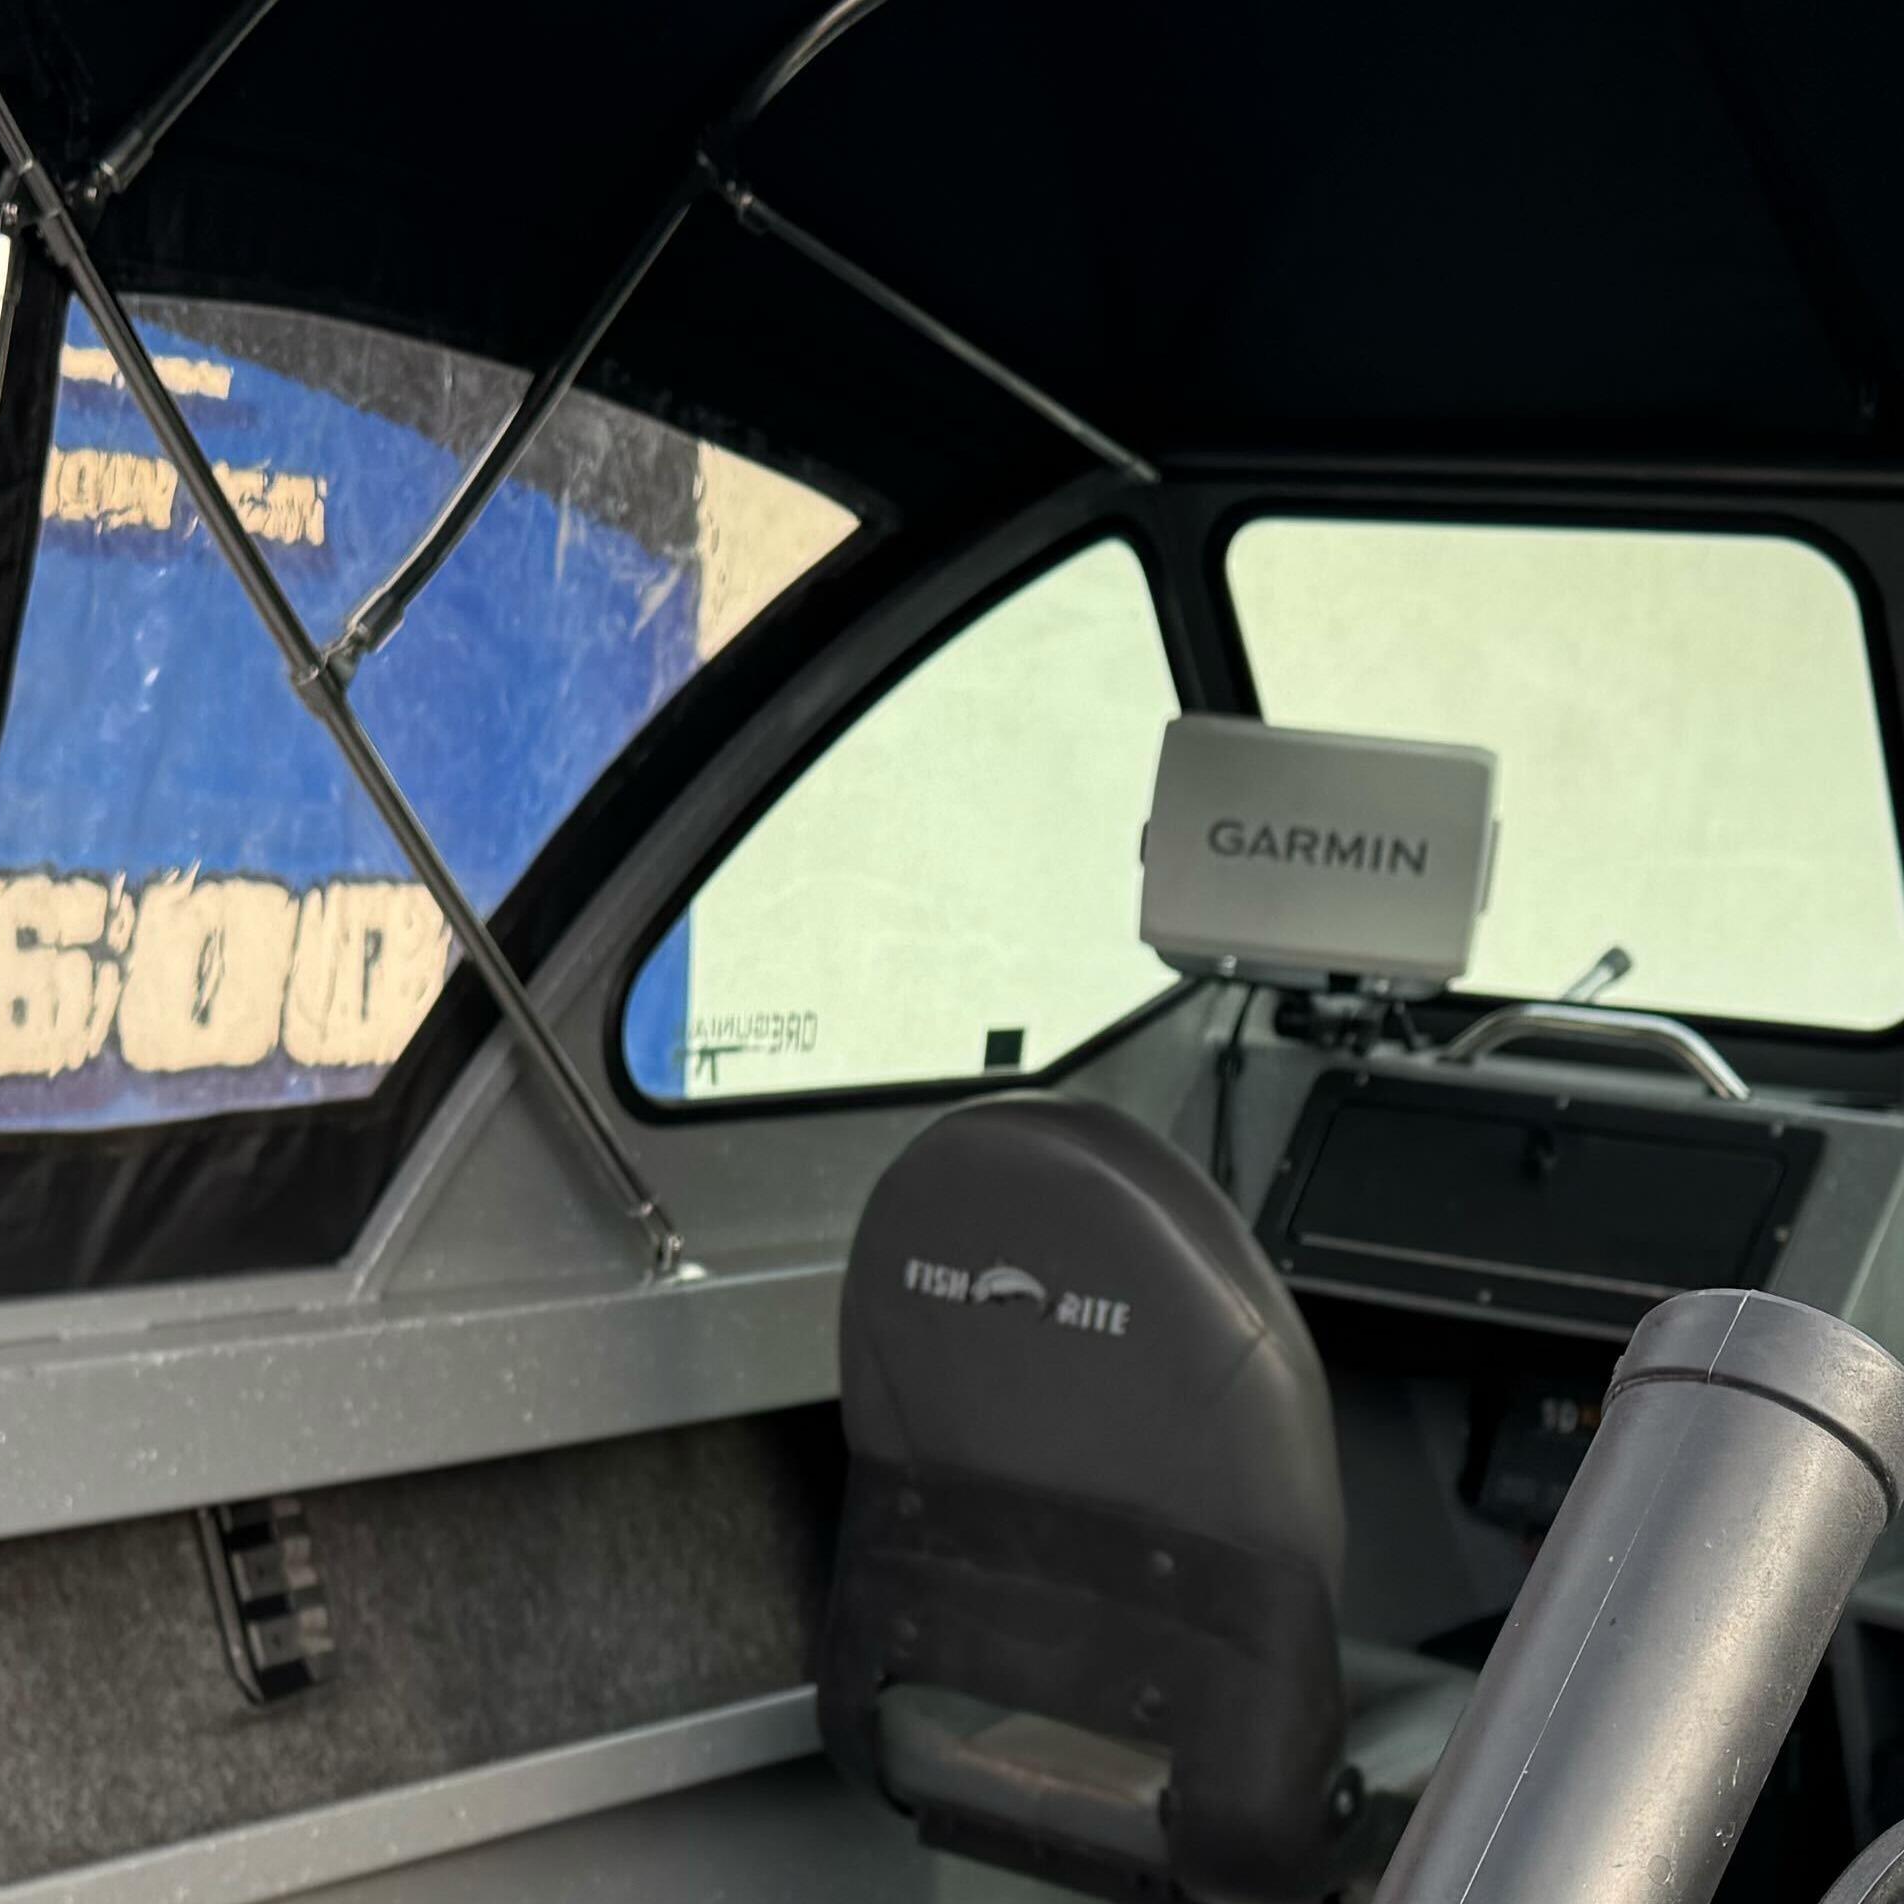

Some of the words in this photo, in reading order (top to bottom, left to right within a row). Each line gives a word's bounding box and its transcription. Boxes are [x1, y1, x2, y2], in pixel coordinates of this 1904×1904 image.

[1207, 818, 1429, 876] GARMIN
[905, 1258, 970, 1301] FISH
[1057, 1291, 1131, 1335] RITE
